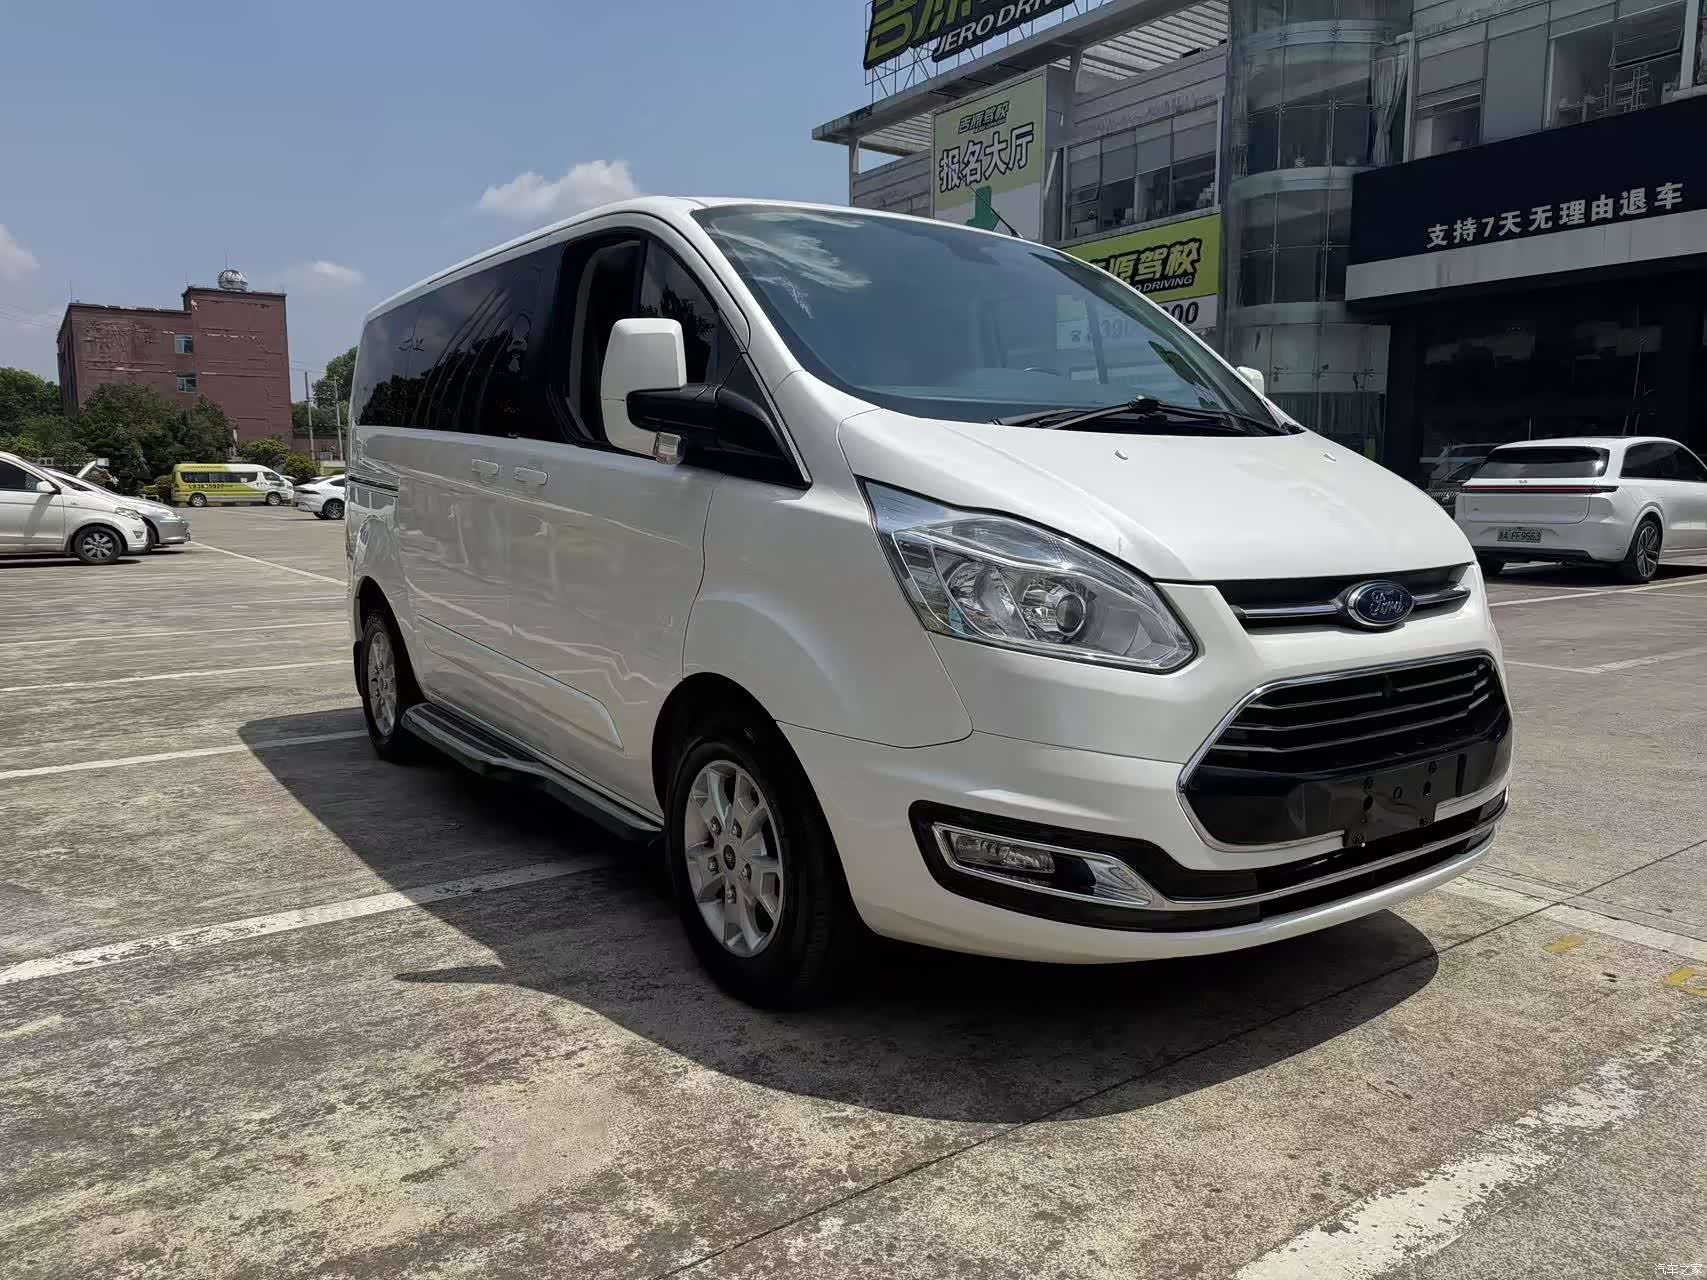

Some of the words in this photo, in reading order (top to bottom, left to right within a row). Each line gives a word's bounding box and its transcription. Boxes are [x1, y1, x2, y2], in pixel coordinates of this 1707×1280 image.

[934, 14, 994, 57] JERO
[940, 122, 1034, 192] 报名大厅
[1426, 182, 1683, 248] 支持7天无理由退车
[1143, 276, 1193, 292] DRIVING
[1369, 590, 1404, 615] Ford
